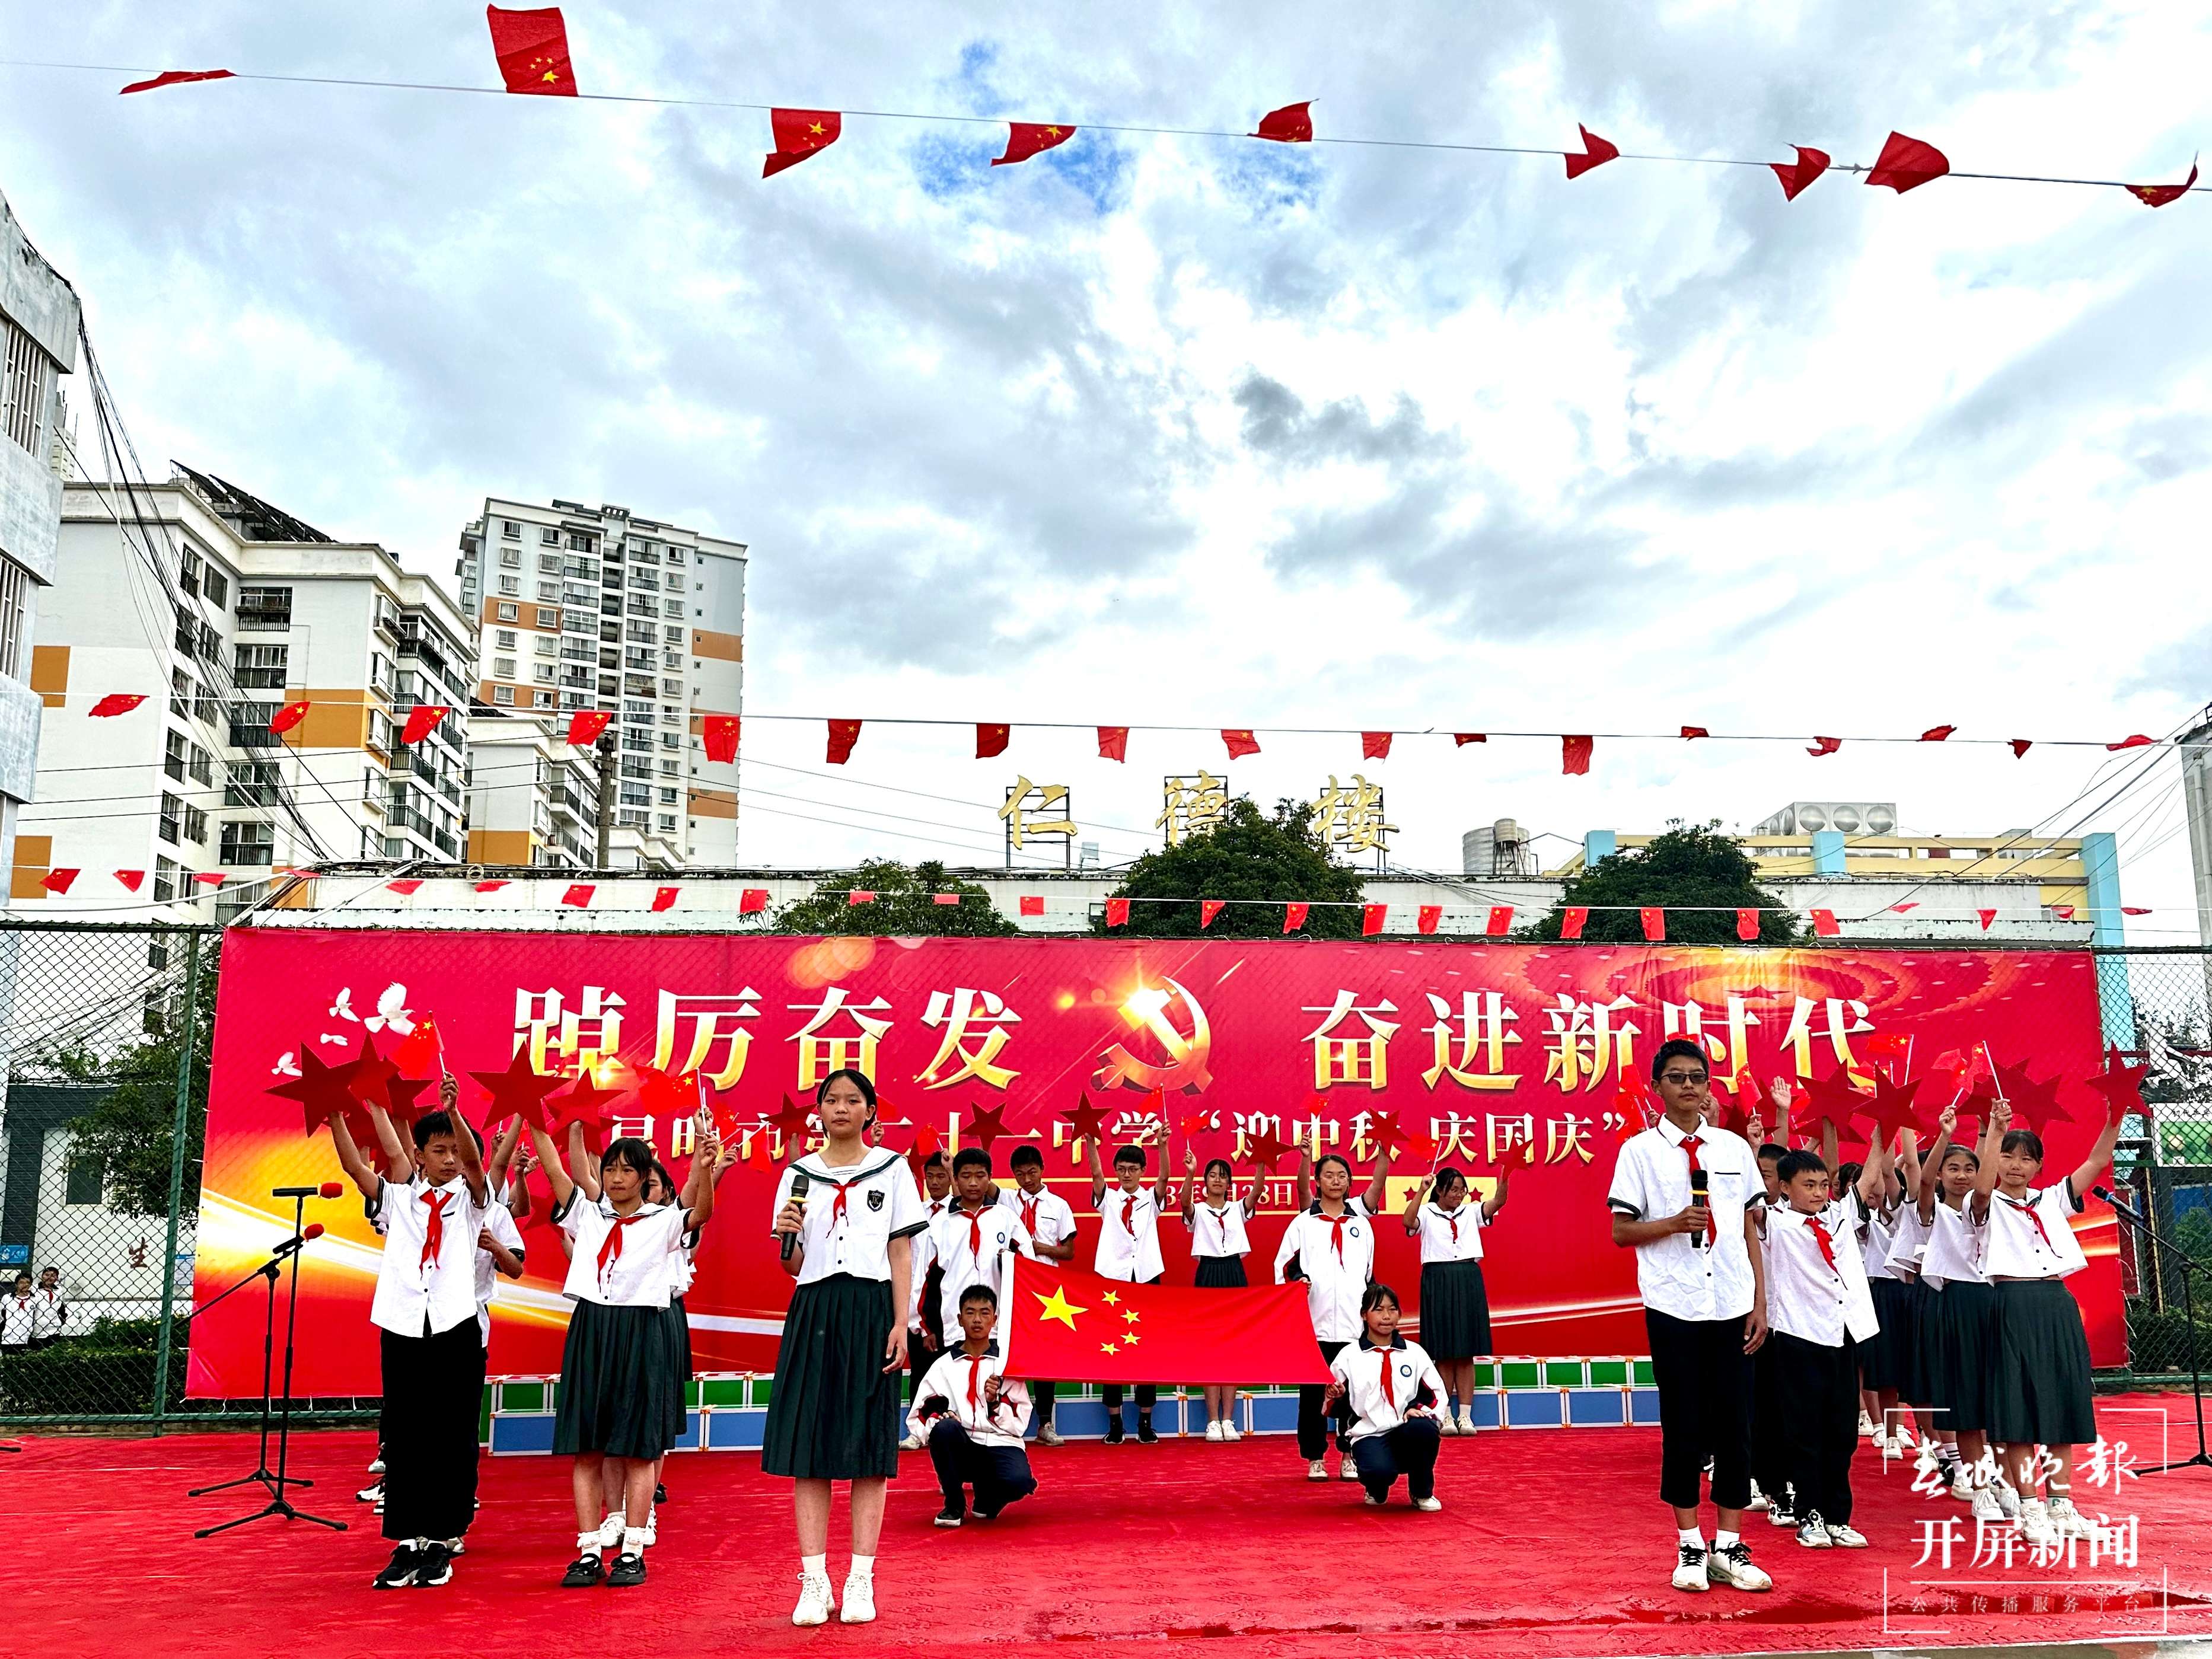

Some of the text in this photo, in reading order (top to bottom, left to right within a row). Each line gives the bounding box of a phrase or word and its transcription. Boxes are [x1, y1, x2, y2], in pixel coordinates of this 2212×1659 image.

[997, 769, 1400, 853] 仁德楼
[512, 985, 1876, 1094] 踔厉奋发 奋进新时代
